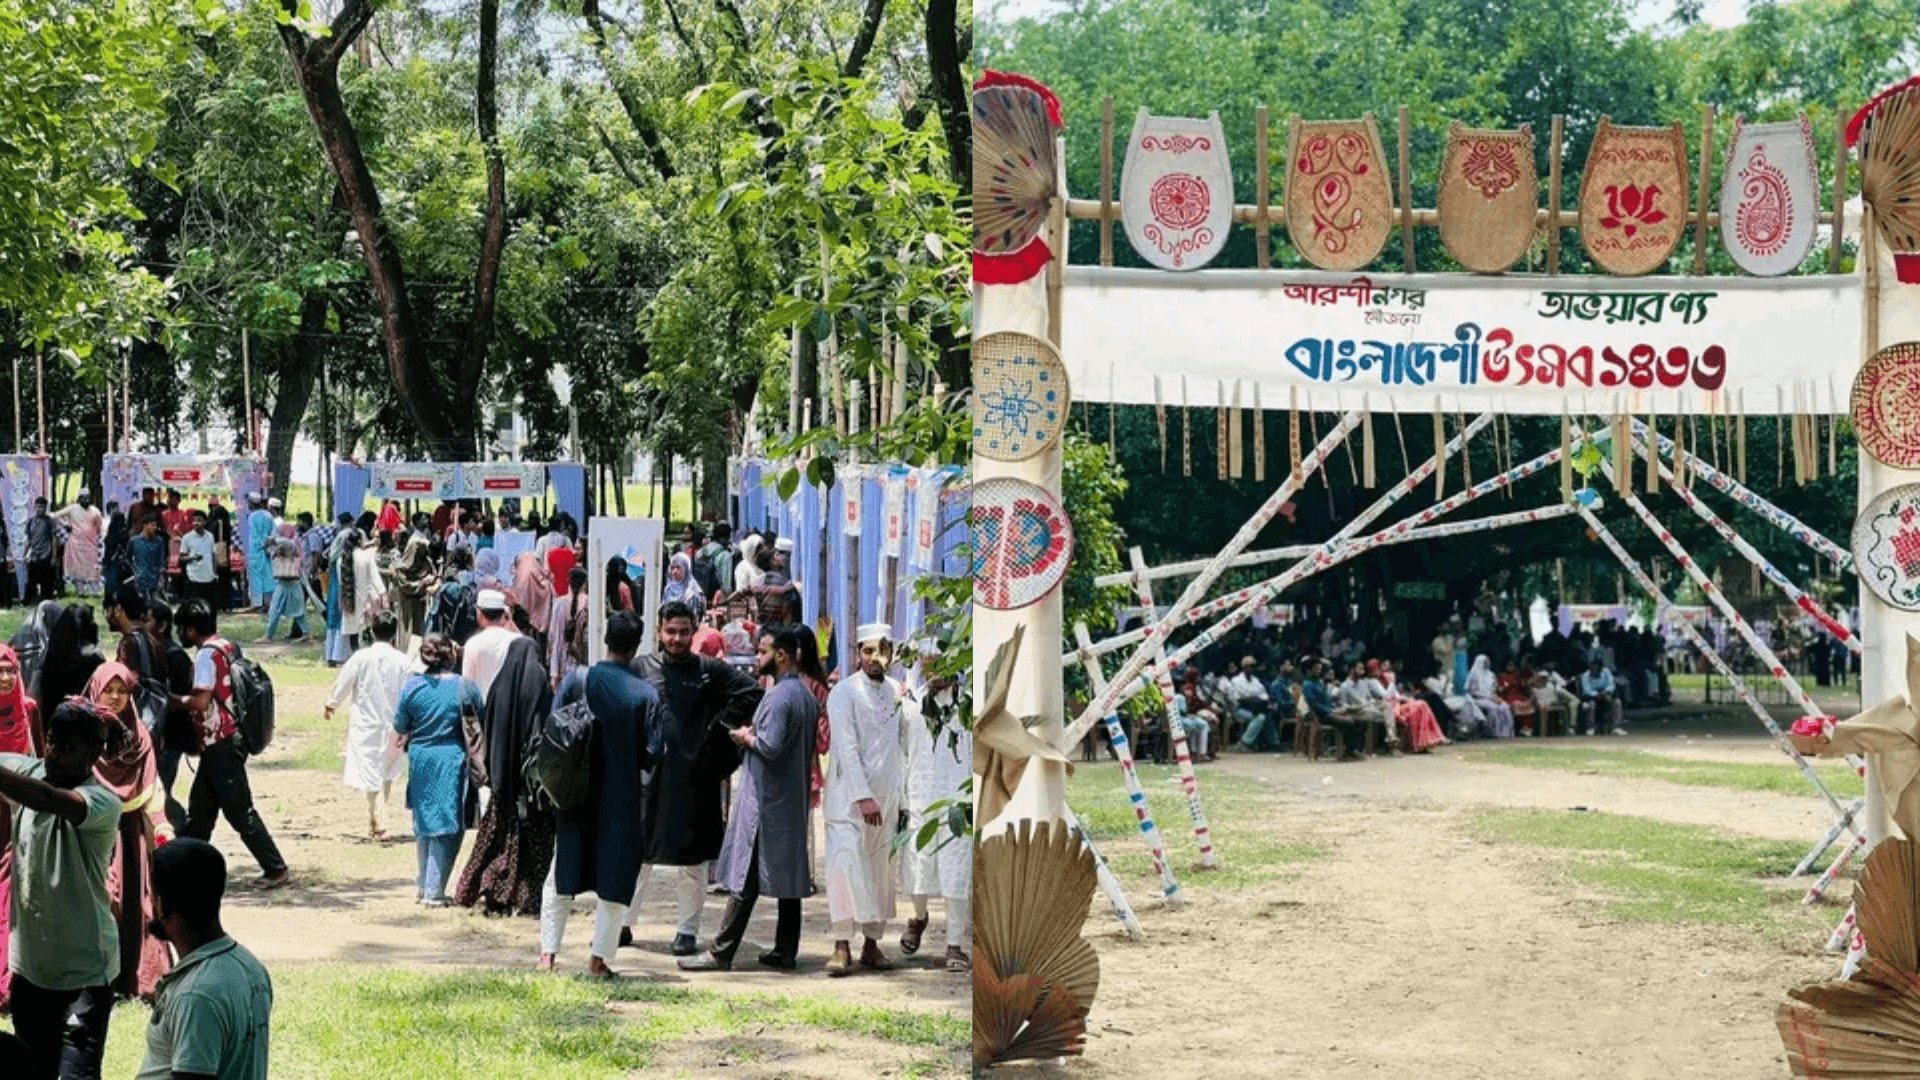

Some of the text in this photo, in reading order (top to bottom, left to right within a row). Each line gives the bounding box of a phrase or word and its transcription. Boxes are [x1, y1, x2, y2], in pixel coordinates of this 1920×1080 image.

[1283, 276, 1427, 310] আরশীনগর
[1537, 291, 1718, 325] অভয়ারণ্য
[1284, 322, 1482, 386] বাংলাদেশী
[1598, 343, 1727, 391] ১৪৩৩
